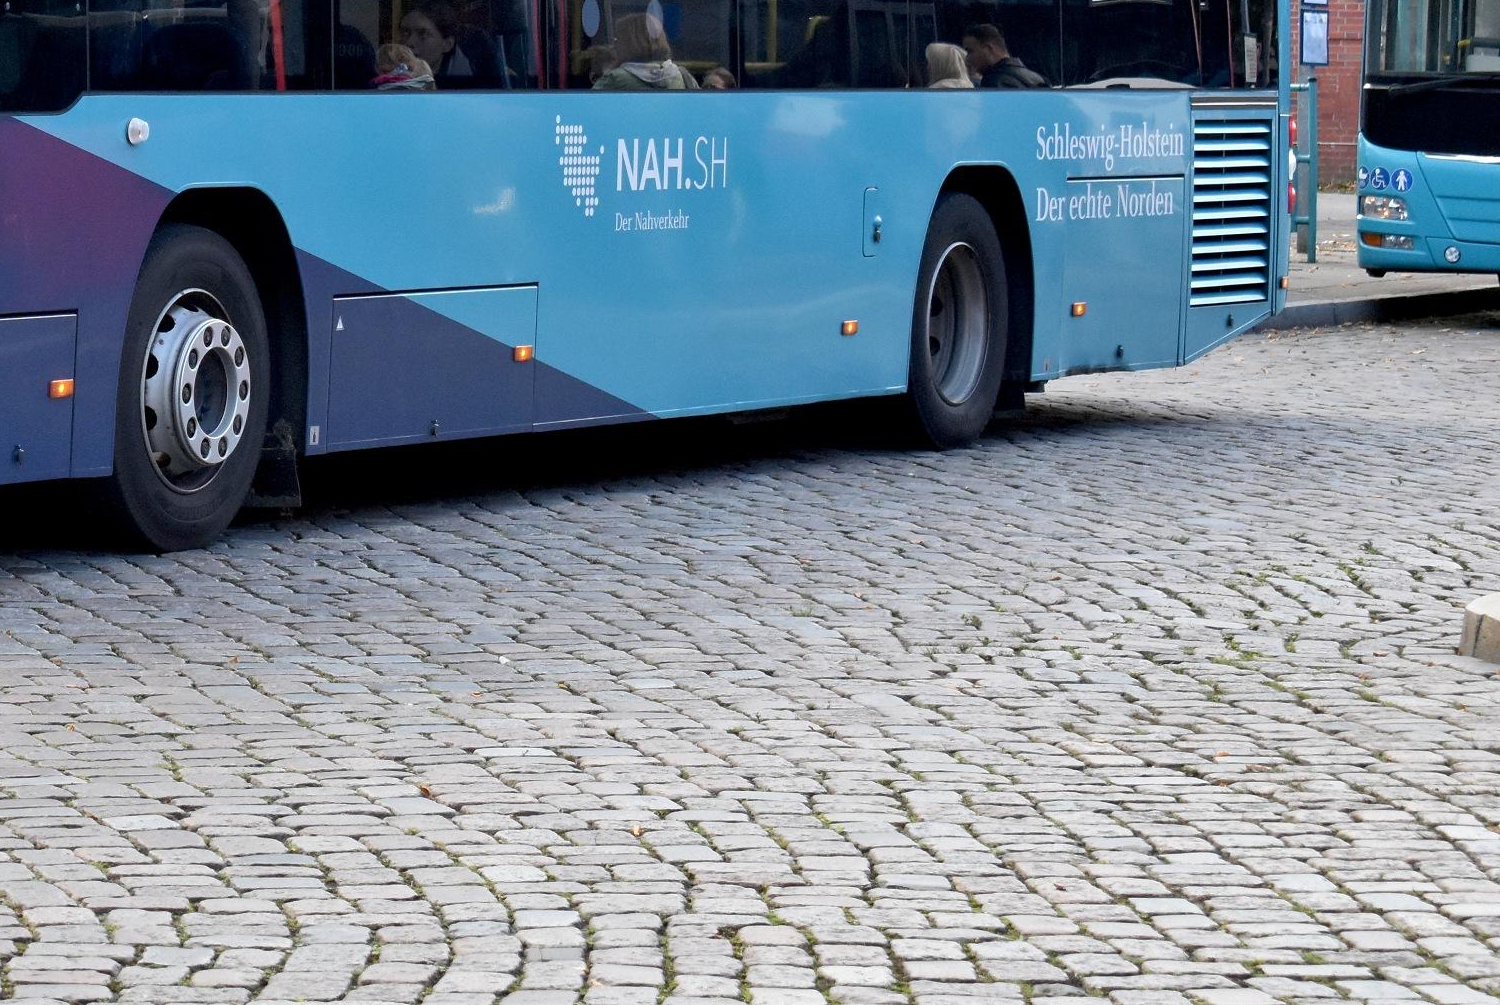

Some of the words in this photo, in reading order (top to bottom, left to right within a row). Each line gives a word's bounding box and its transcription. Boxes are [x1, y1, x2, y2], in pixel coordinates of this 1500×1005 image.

[616, 136, 727, 191] NAH.SH
[1036, 122, 1185, 171] Schleswig-Holstein
[615, 212, 632, 232] Der
[635, 209, 690, 231] Nahverkehr
[1035, 187, 1066, 222] Der
[1069, 183, 1112, 219] echte
[1116, 181, 1174, 218] Norden
